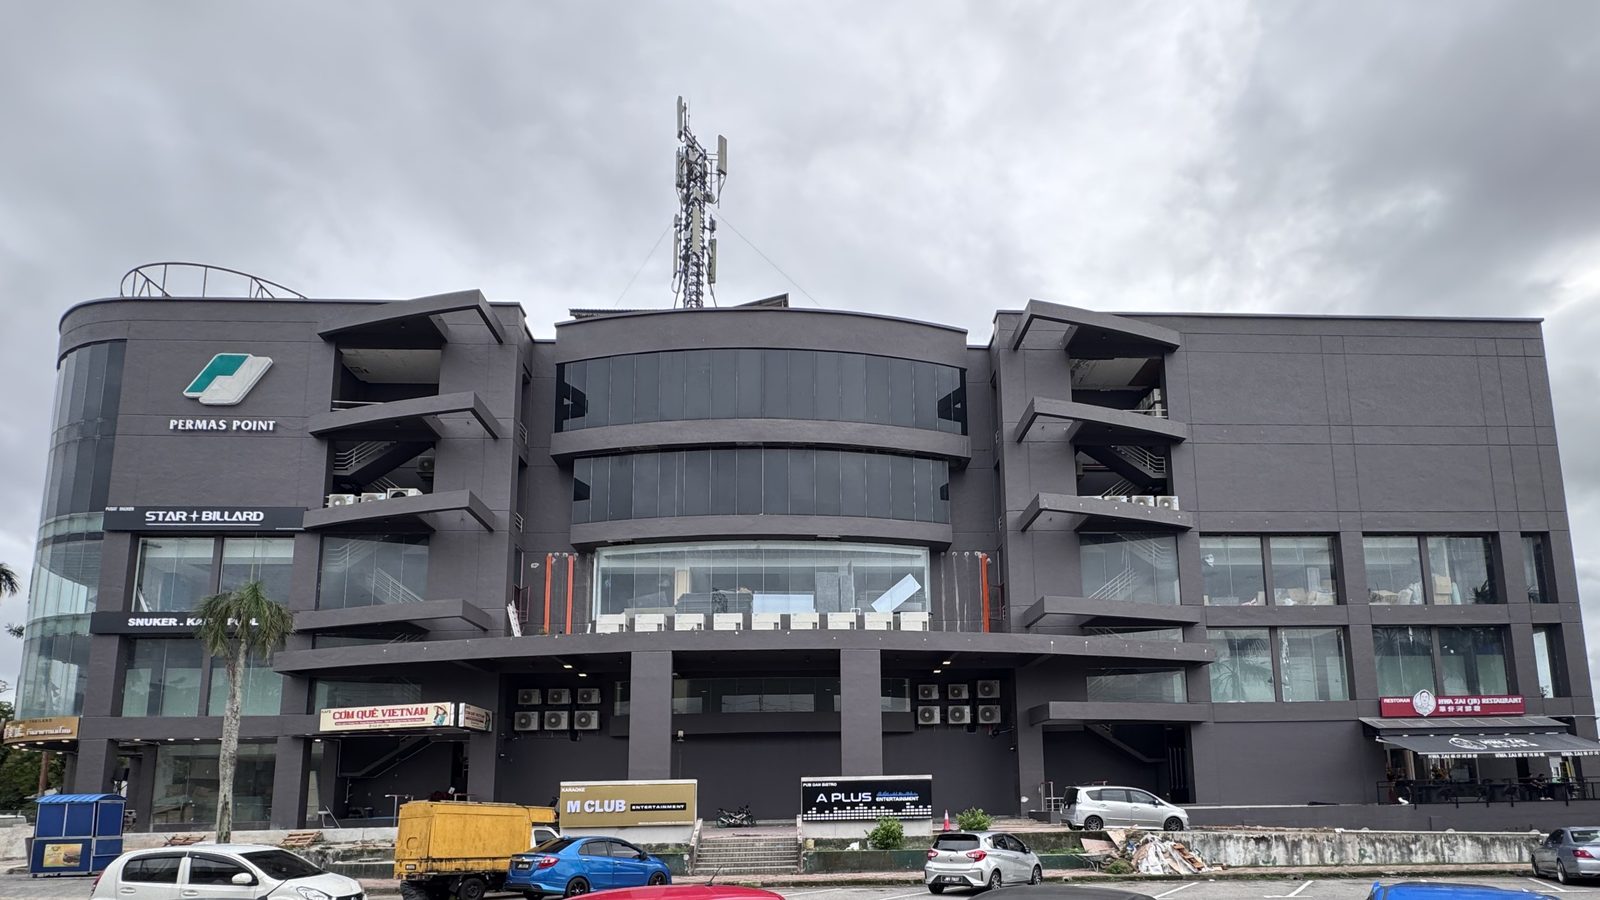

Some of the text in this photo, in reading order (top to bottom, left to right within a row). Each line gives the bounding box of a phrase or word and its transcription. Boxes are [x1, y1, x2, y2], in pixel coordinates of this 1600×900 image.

[169, 419, 276, 431] PERMAS POINT
[145, 511, 264, 521] STAR BILLARD
[128, 618, 177, 626] SNUKER
[381, 707, 429, 717] VIETNAM
[816, 792, 872, 803] A PLUS
[567, 799, 626, 813] M CLUB
